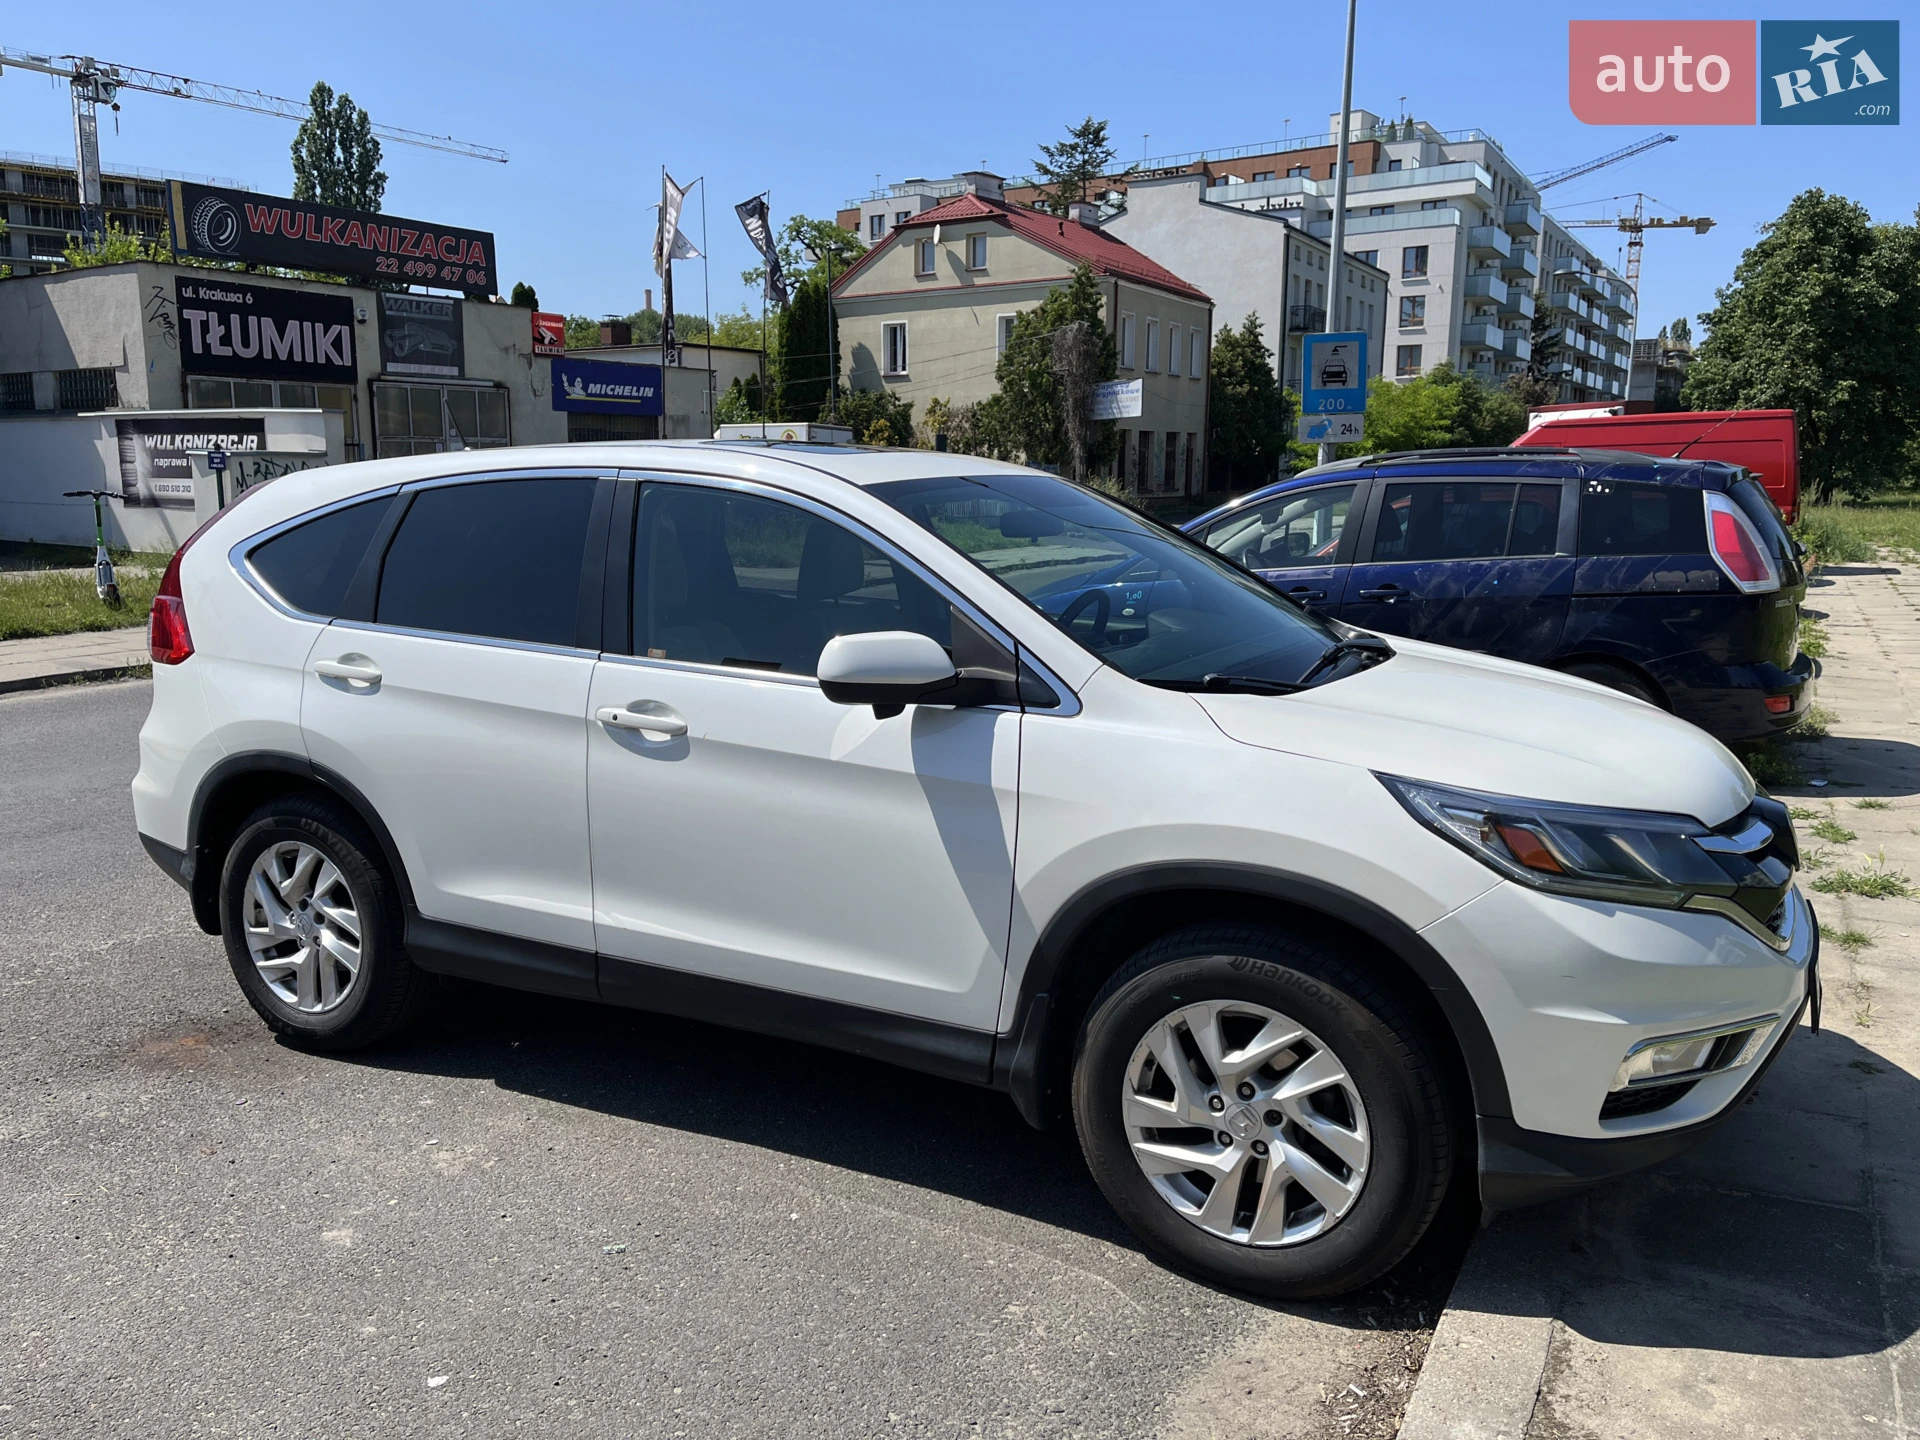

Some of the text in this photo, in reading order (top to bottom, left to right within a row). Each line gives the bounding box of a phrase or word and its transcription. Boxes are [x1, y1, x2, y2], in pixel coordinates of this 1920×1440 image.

[244, 203, 486, 266] WULKANIZACJA
[375, 256, 487, 285] 22 499 47 06
[181, 286, 253, 304] ul. Krakusa 6
[381, 293, 454, 320] WALKER
[182, 309, 352, 367] TŁUMIKI
[587, 383, 654, 397] MICHELIN
[1318, 398, 1345, 410] 200
[1340, 423, 1360, 435] 24 h
[144, 434, 258, 450] WULKANIZACJA
[154, 458, 187, 468] naprawa
